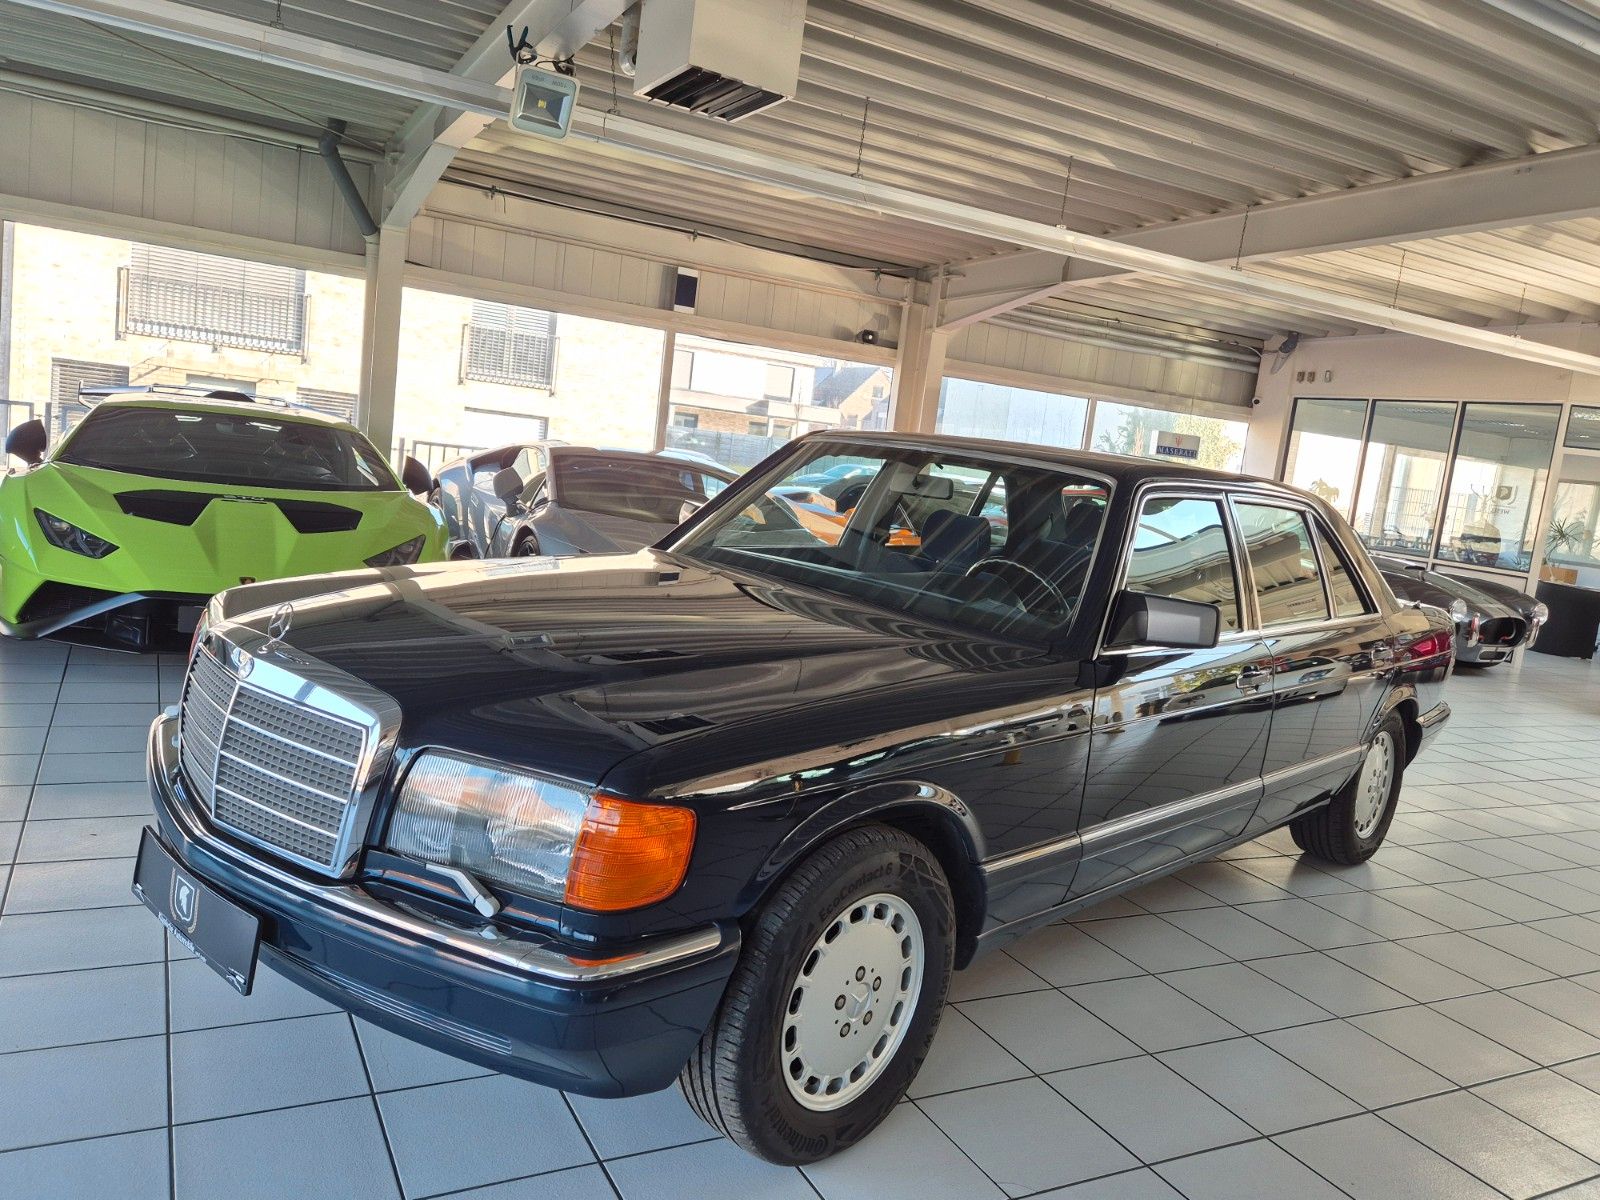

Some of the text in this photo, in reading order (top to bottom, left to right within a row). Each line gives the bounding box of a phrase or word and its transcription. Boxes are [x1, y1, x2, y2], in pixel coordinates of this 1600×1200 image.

[1157, 446, 1198, 458] MASERATI
[819, 862, 894, 921] EcoContact 6
[764, 1101, 829, 1156] Continental
